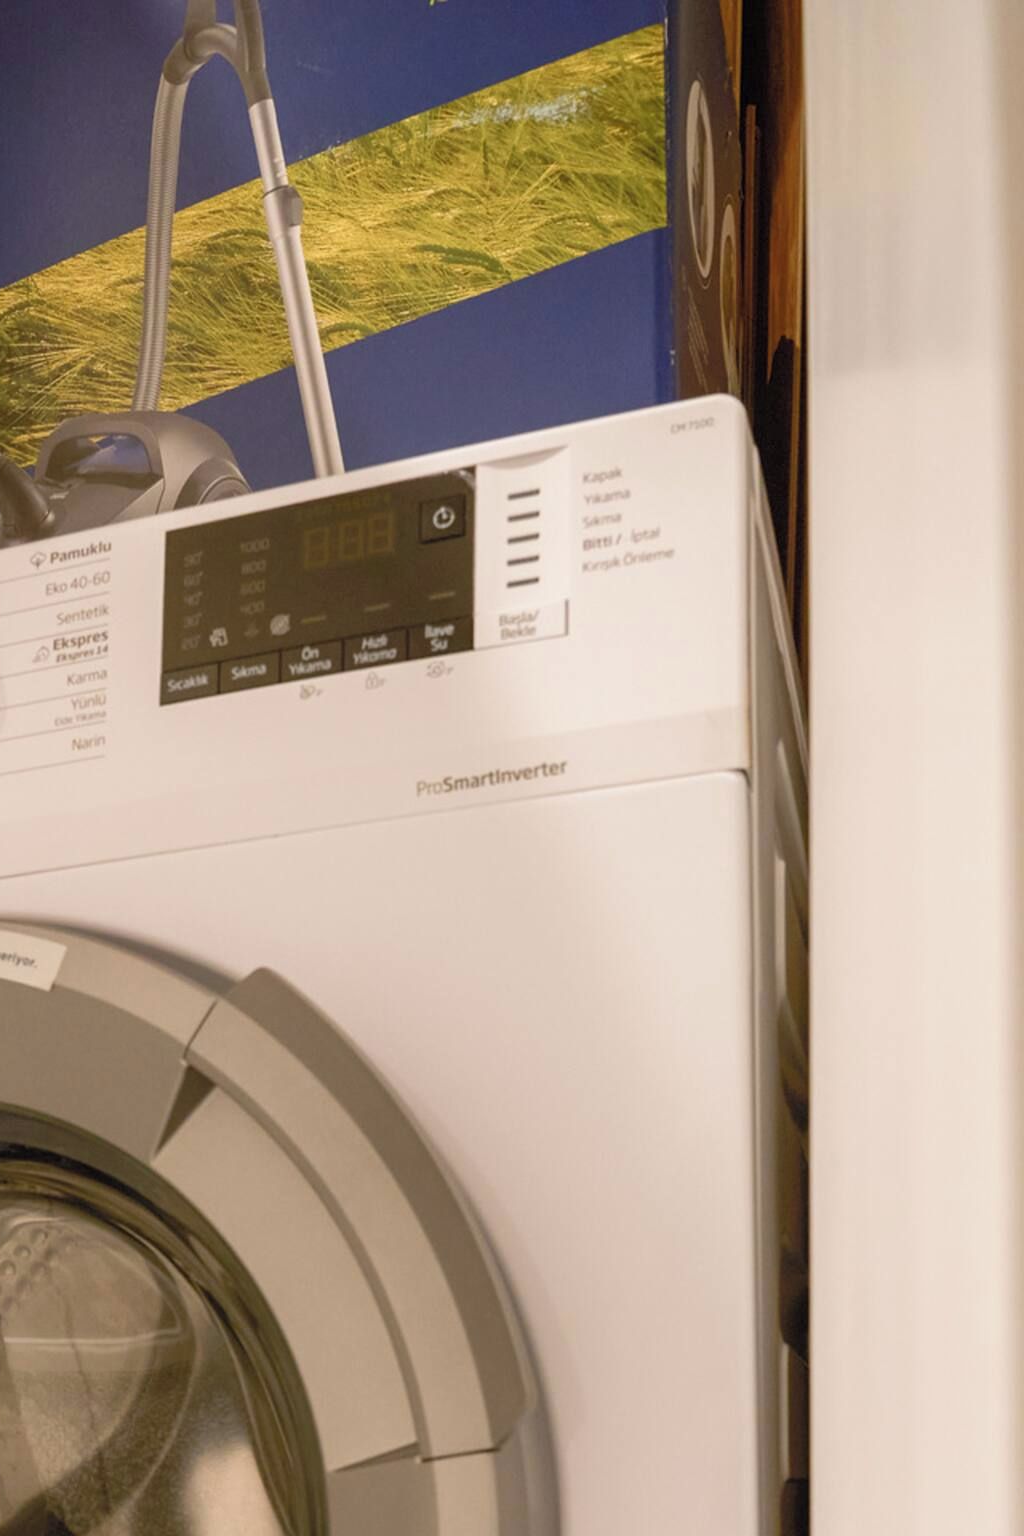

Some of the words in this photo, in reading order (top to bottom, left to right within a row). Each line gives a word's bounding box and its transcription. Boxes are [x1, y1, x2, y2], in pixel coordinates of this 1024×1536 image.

[582, 467, 622, 484] Kapak
[583, 489, 631, 505] Yıkama
[582, 513, 622, 528] Sıkma
[239, 537, 271, 553] 1000
[582, 534, 613, 551] Bitti
[49, 541, 112, 564] Pamuklu
[623, 547, 675, 567] Önleme
[45, 582, 68, 597] Eko
[69, 570, 111, 590] 40-60
[56, 605, 110, 626] Sentetik
[52, 630, 109, 652] Ekspres
[500, 625, 536, 640] Bekle
[96, 644, 109, 656] 14
[301, 645, 320, 661] Ön
[430, 638, 449, 652] Su
[353, 647, 398, 664] Yıkama
[230, 662, 267, 680] Sıkma
[288, 658, 332, 676] Yıkama
[66, 669, 108, 687] Karma
[167, 673, 209, 692] Sıcaklık
[70, 693, 107, 711] Yünlü
[71, 735, 107, 751] Narin
[416, 761, 568, 797] ProSmartInverter
